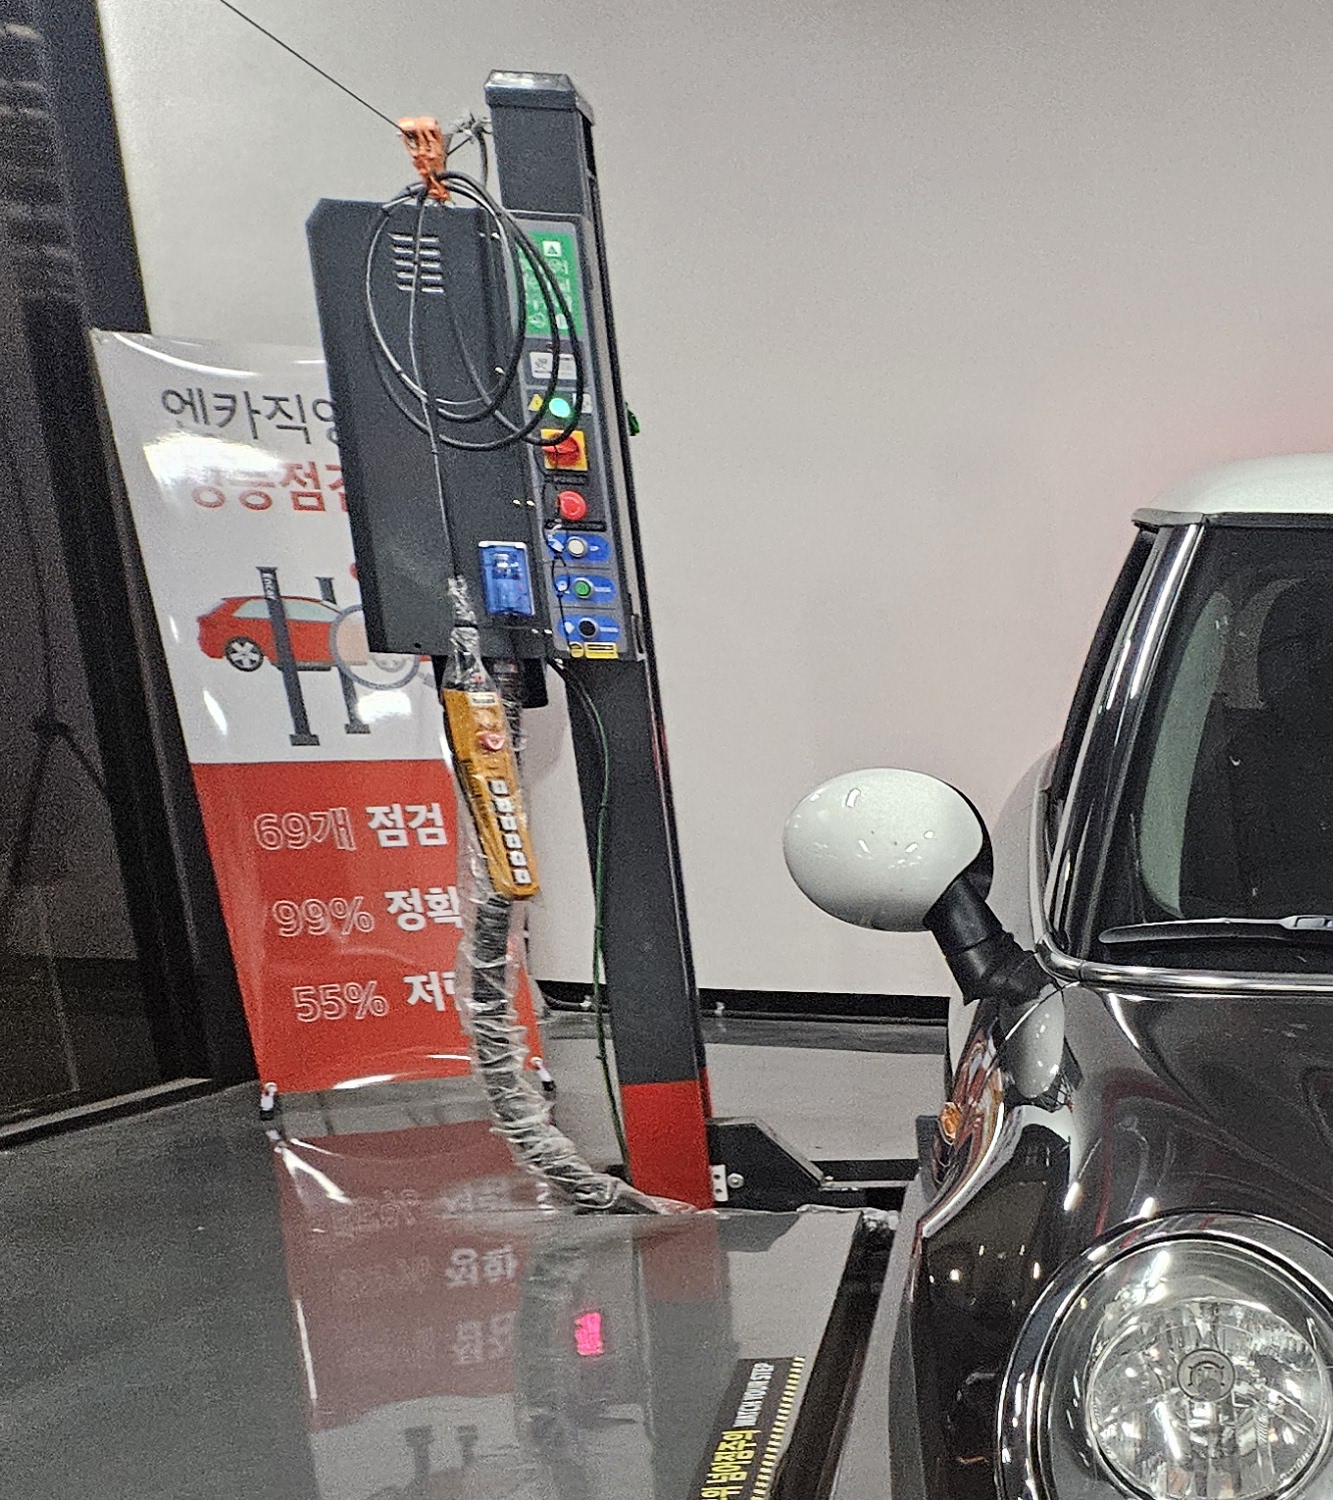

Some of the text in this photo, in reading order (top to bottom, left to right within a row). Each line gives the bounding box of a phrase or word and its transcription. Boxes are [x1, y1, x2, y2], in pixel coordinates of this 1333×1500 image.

[253, 802, 448, 851] 69개 점검
[271, 895, 375, 937] 99%
[291, 980, 390, 1023] 55%
[706, 1429, 762, 1484] 넘어짐주의
